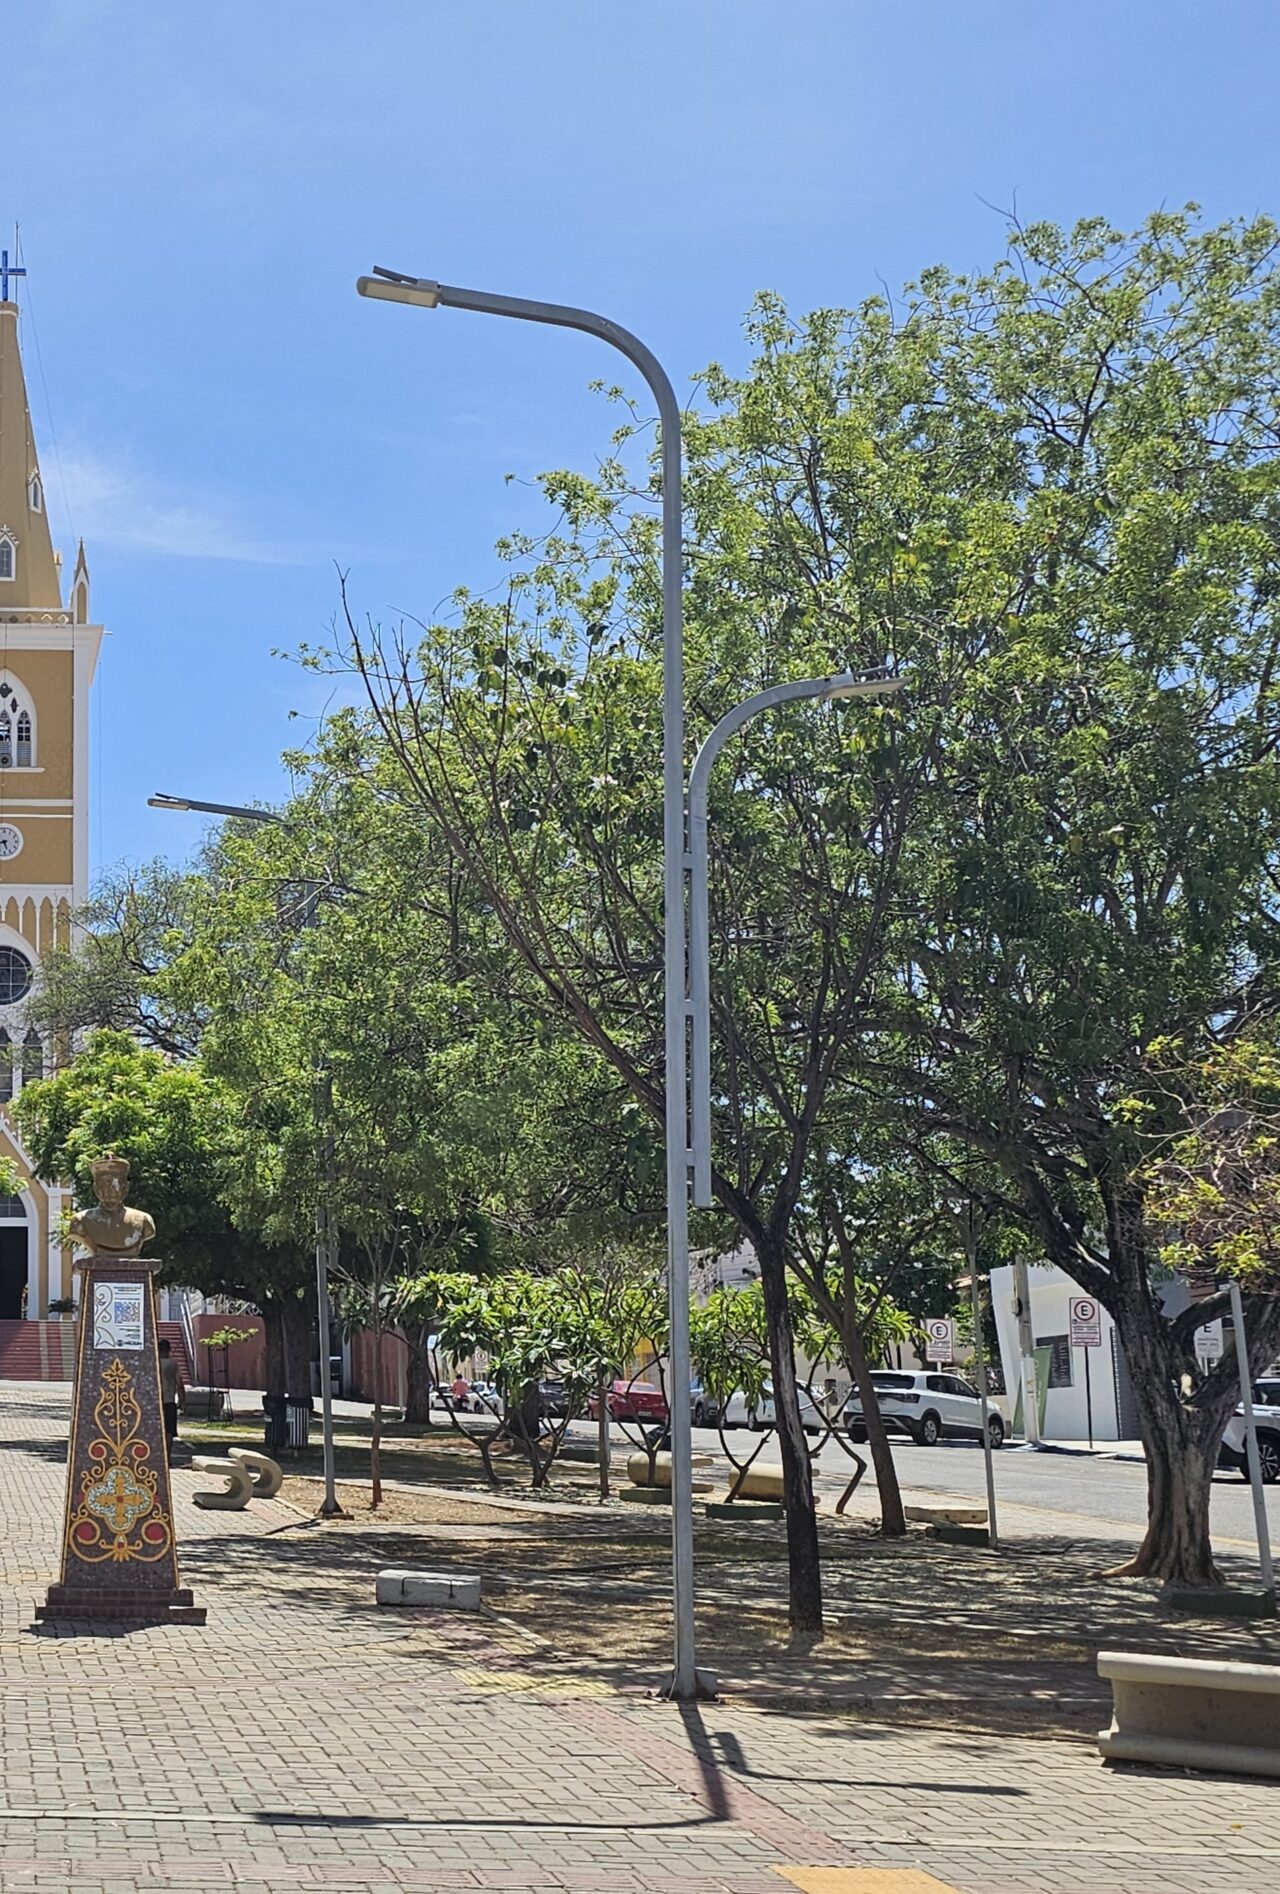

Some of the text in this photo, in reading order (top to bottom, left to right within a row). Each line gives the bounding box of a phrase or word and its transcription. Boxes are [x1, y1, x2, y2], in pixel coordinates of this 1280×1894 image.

[1080, 1305, 1089, 1316] E
[936, 1326, 943, 1336] E
[1204, 1322, 1212, 1333] E
